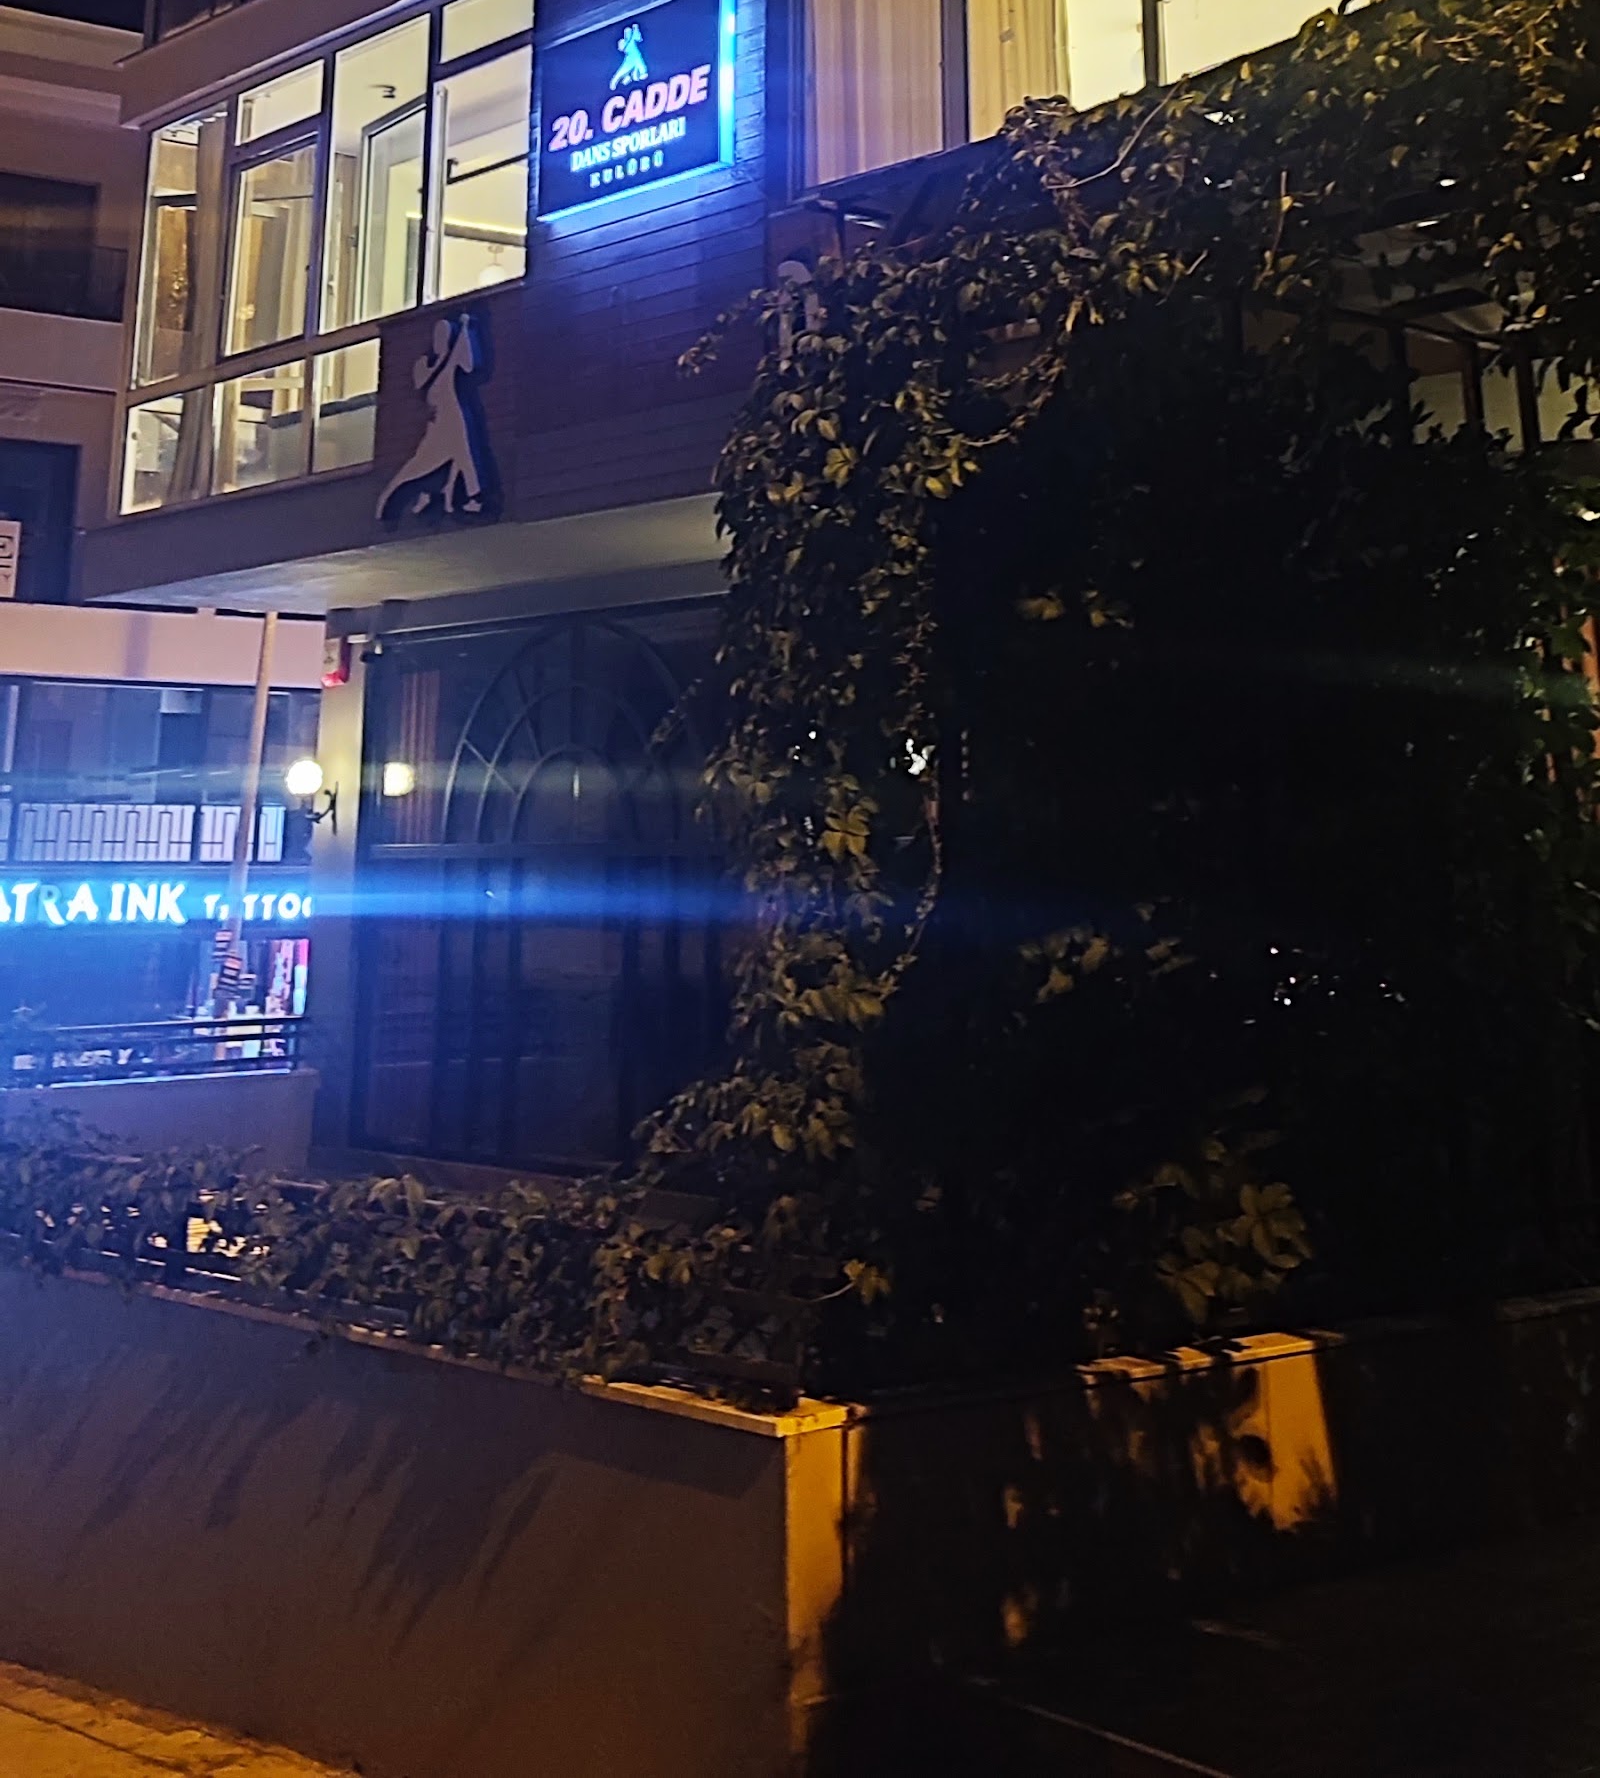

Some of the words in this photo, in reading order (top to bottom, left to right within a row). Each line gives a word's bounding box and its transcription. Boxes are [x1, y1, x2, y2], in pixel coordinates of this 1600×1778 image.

[548, 109, 595, 152] 20.
[601, 63, 712, 133] CADDE
[569, 140, 612, 173] DANS
[611, 115, 687, 159] SPORLARI
[107, 880, 188, 926] INK
